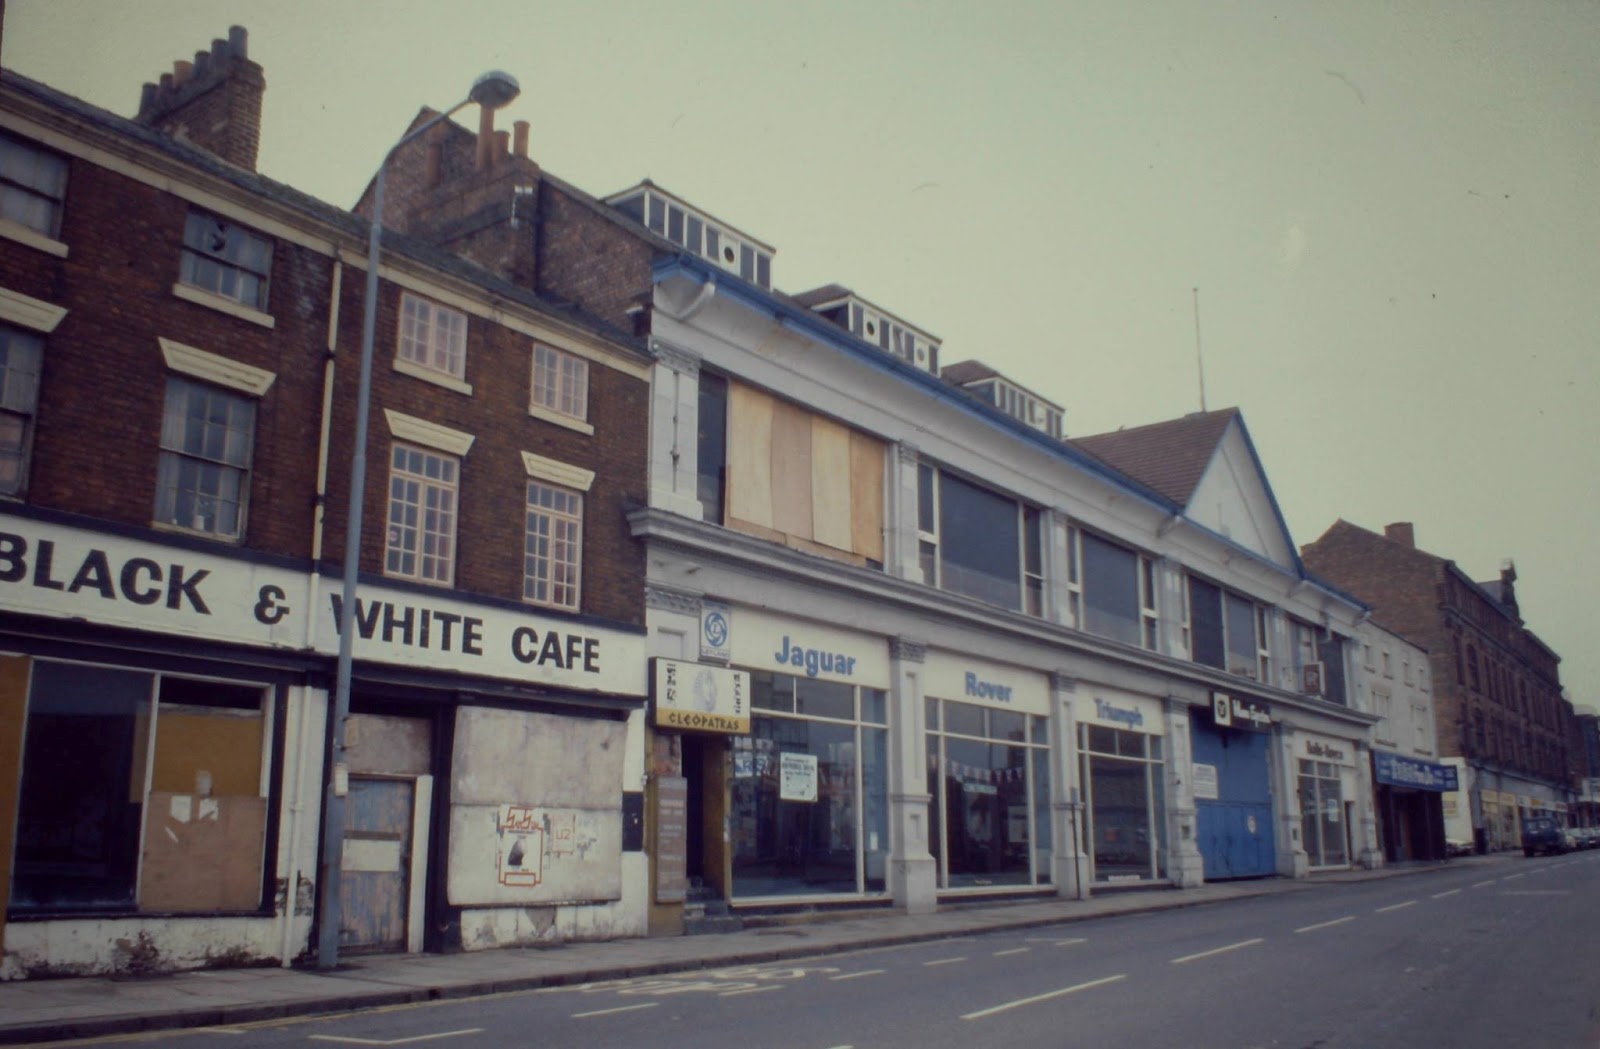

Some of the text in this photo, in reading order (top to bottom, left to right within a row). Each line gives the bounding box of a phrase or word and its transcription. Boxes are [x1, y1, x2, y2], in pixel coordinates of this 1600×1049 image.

[0, 535, 600, 673] BLACK & WHITE CAFE
[774, 635, 856, 677] Jaguar
[965, 671, 1013, 703] Rover
[668, 712, 740, 731] CLEOPATRAS
[1093, 698, 1144, 729] Triumph
